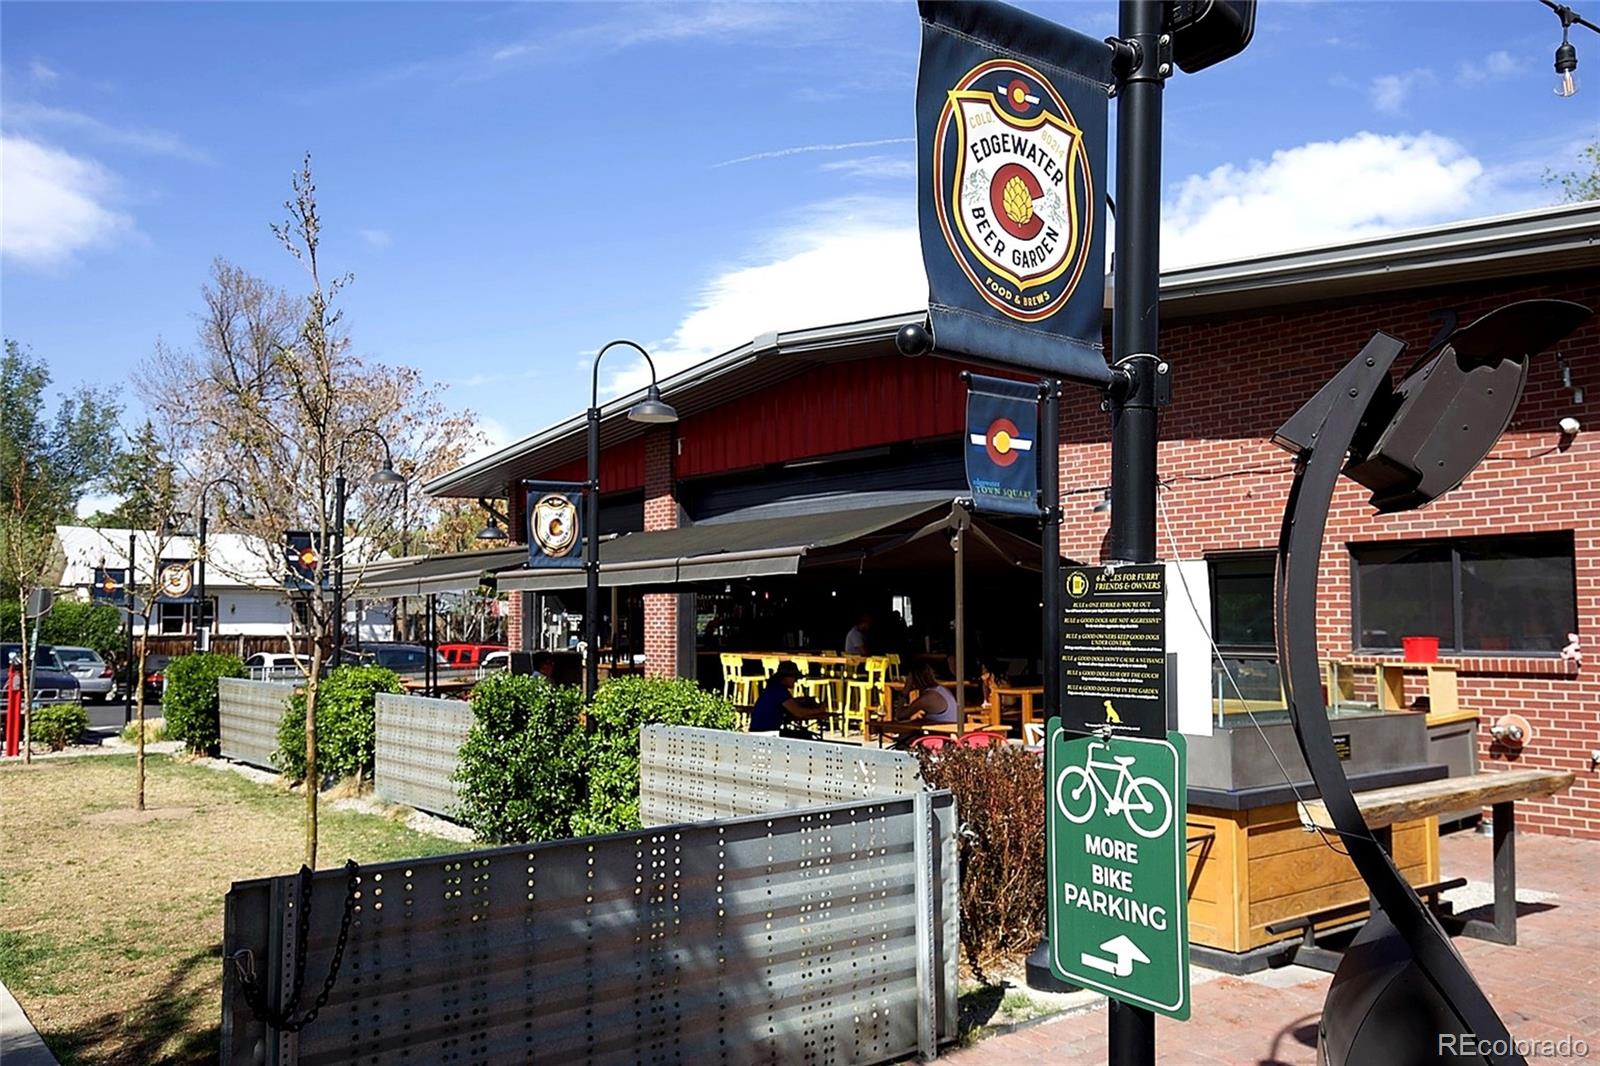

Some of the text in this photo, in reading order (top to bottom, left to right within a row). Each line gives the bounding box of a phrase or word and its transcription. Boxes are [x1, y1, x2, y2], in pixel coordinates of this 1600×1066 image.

[970, 133, 1064, 187] EDGEWATER
[972, 206, 1059, 268] BEER GARDEN
[985, 277, 1051, 306] FOOD & BREWS
[975, 486, 1001, 495] TOWN
[1095, 582, 1123, 590] FRIENDS
[1130, 581, 1161, 590] OWNERS
[1101, 573, 1122, 582] RES
[1122, 573, 1137, 582] FOR
[1137, 572, 1160, 581] FURRY
[1085, 833, 1139, 864] MORE
[1091, 864, 1133, 893] BIKE
[1064, 883, 1167, 930] PARKING
